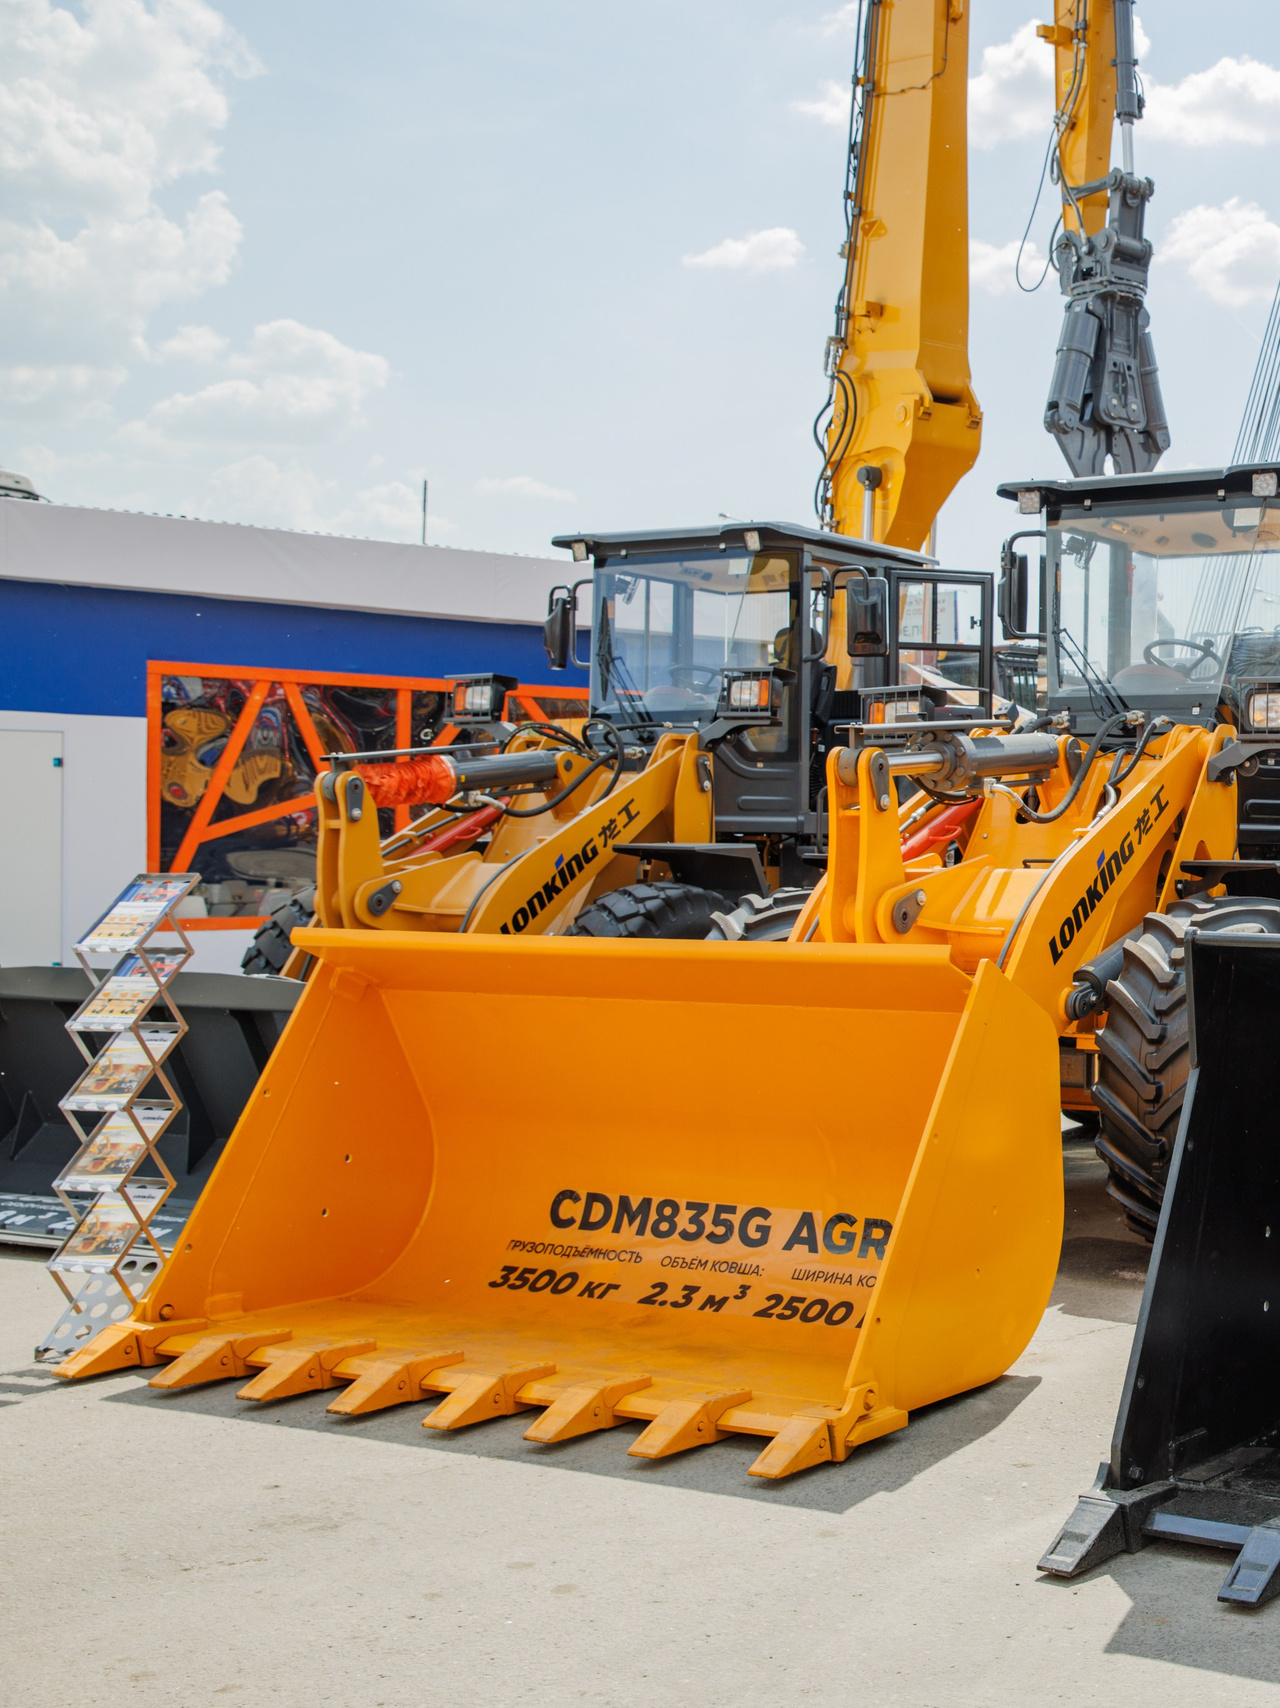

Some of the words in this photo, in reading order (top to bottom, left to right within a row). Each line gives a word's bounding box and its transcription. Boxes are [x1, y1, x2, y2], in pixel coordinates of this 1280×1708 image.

[598, 798, 640, 848] 龙工
[1133, 784, 1169, 845] 龙工
[550, 1189, 773, 1248] CDM835G
[781, 1211, 893, 1261] AGR
[506, 1239, 643, 1264] ГРУЗОПОДЪЁМНОСТЬ
[709, 1260, 765, 1277] КОВША:
[791, 1267, 853, 1286] ШИРИНА
[488, 1265, 579, 1295] 3500
[577, 1281, 621, 1299] кг
[637, 1281, 701, 1309] 2.3
[752, 1293, 854, 1326] 2500
